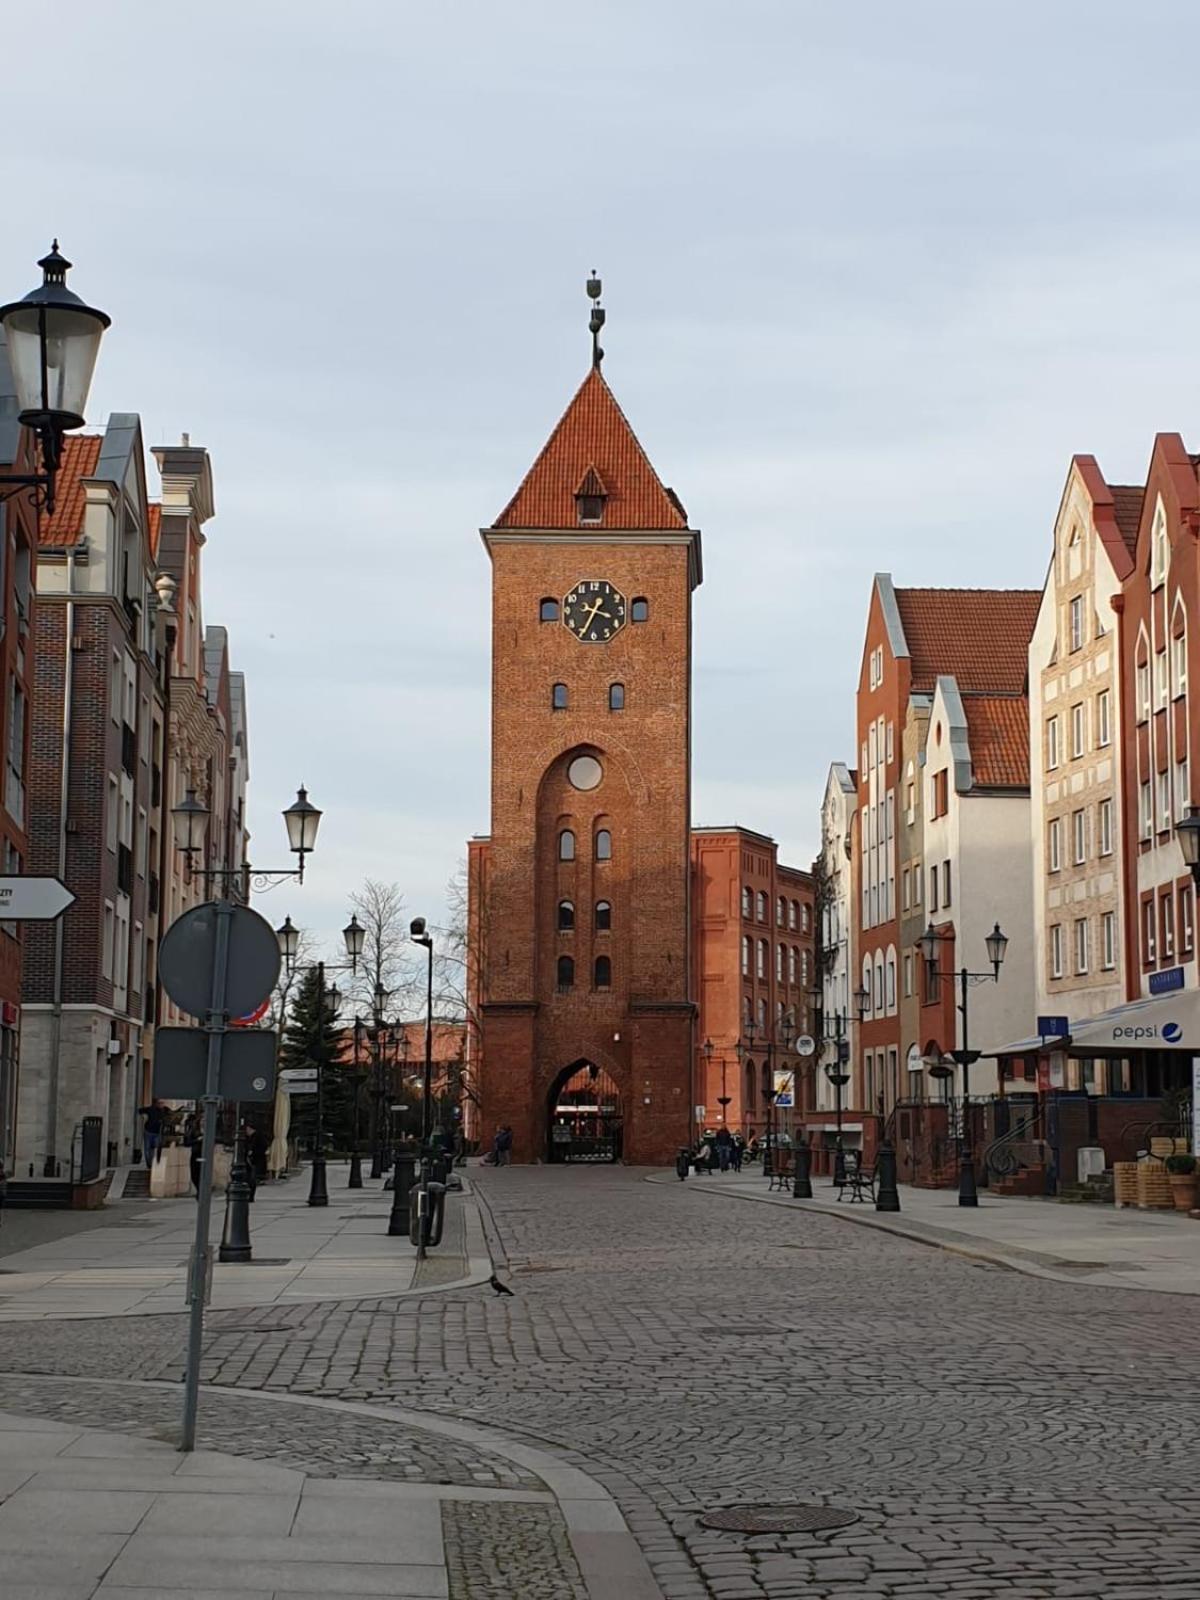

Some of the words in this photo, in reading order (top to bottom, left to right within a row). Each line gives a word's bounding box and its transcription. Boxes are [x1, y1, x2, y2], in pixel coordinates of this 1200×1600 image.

[590, 582, 599, 591] 12
[568, 594, 577, 603] 10
[1113, 1024, 1157, 1040] pepsi
